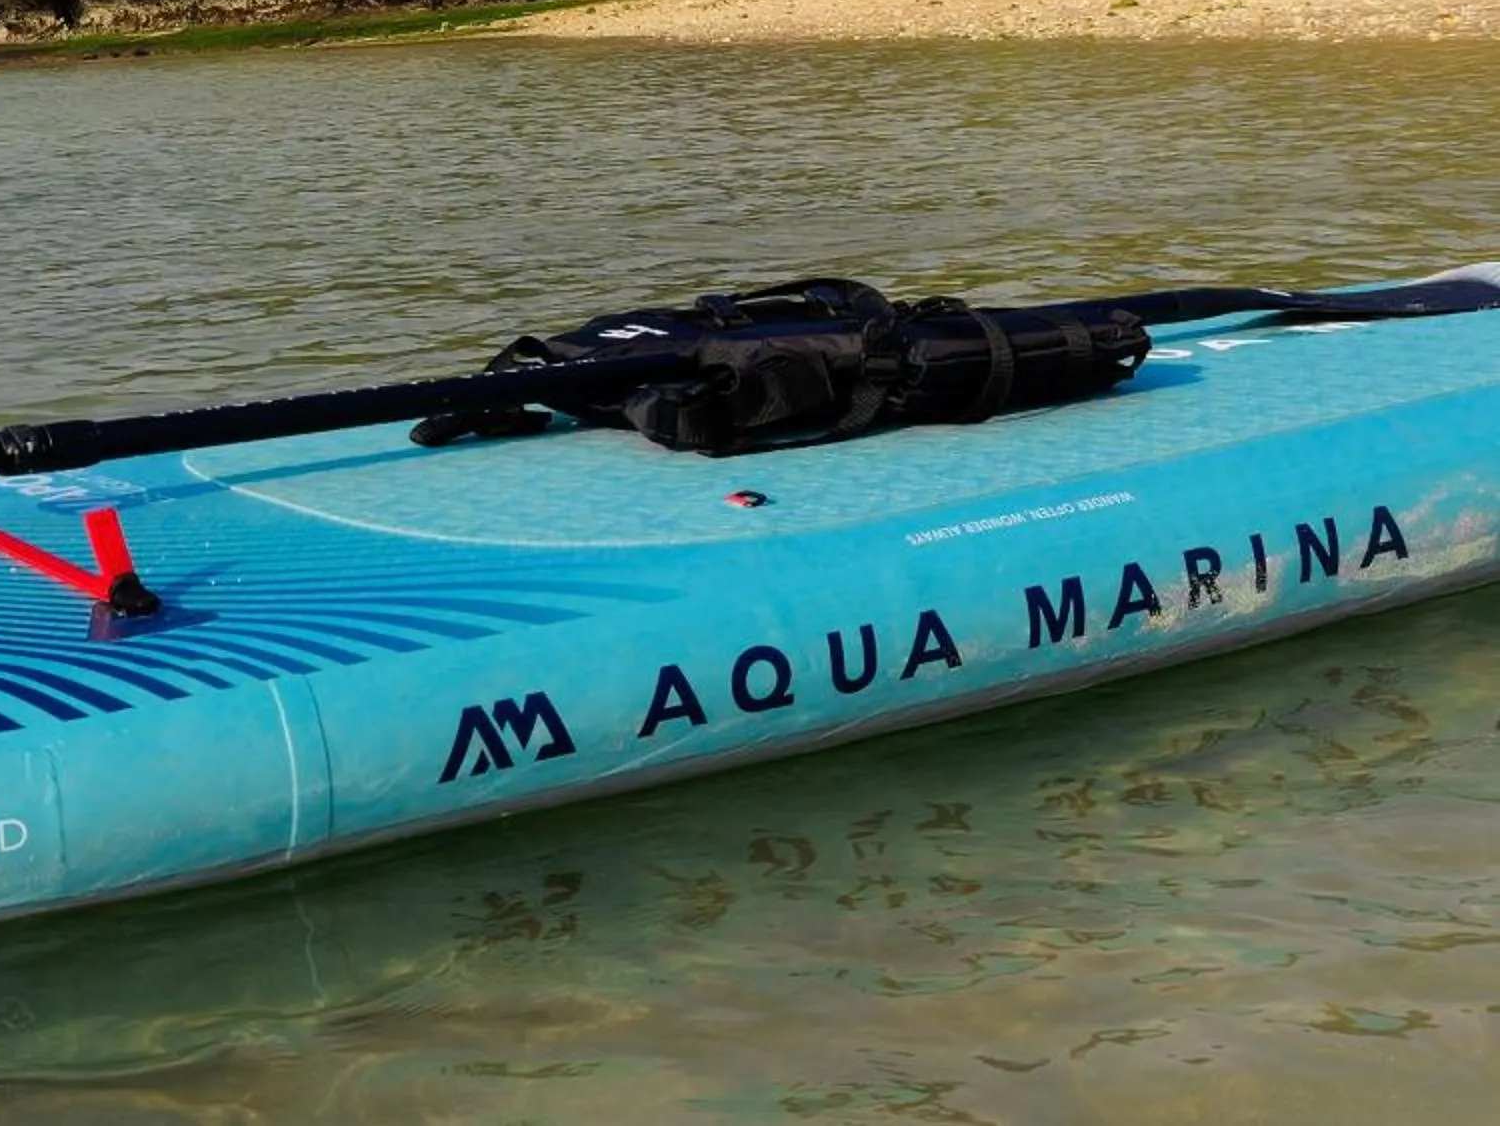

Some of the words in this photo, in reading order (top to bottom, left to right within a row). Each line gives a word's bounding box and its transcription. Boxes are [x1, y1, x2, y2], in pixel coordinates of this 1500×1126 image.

[1076, 490, 1135, 512] WANDER
[962, 511, 1025, 535] WONDER
[636, 609, 963, 739] AQUA
[1024, 505, 1409, 649] MARINA
